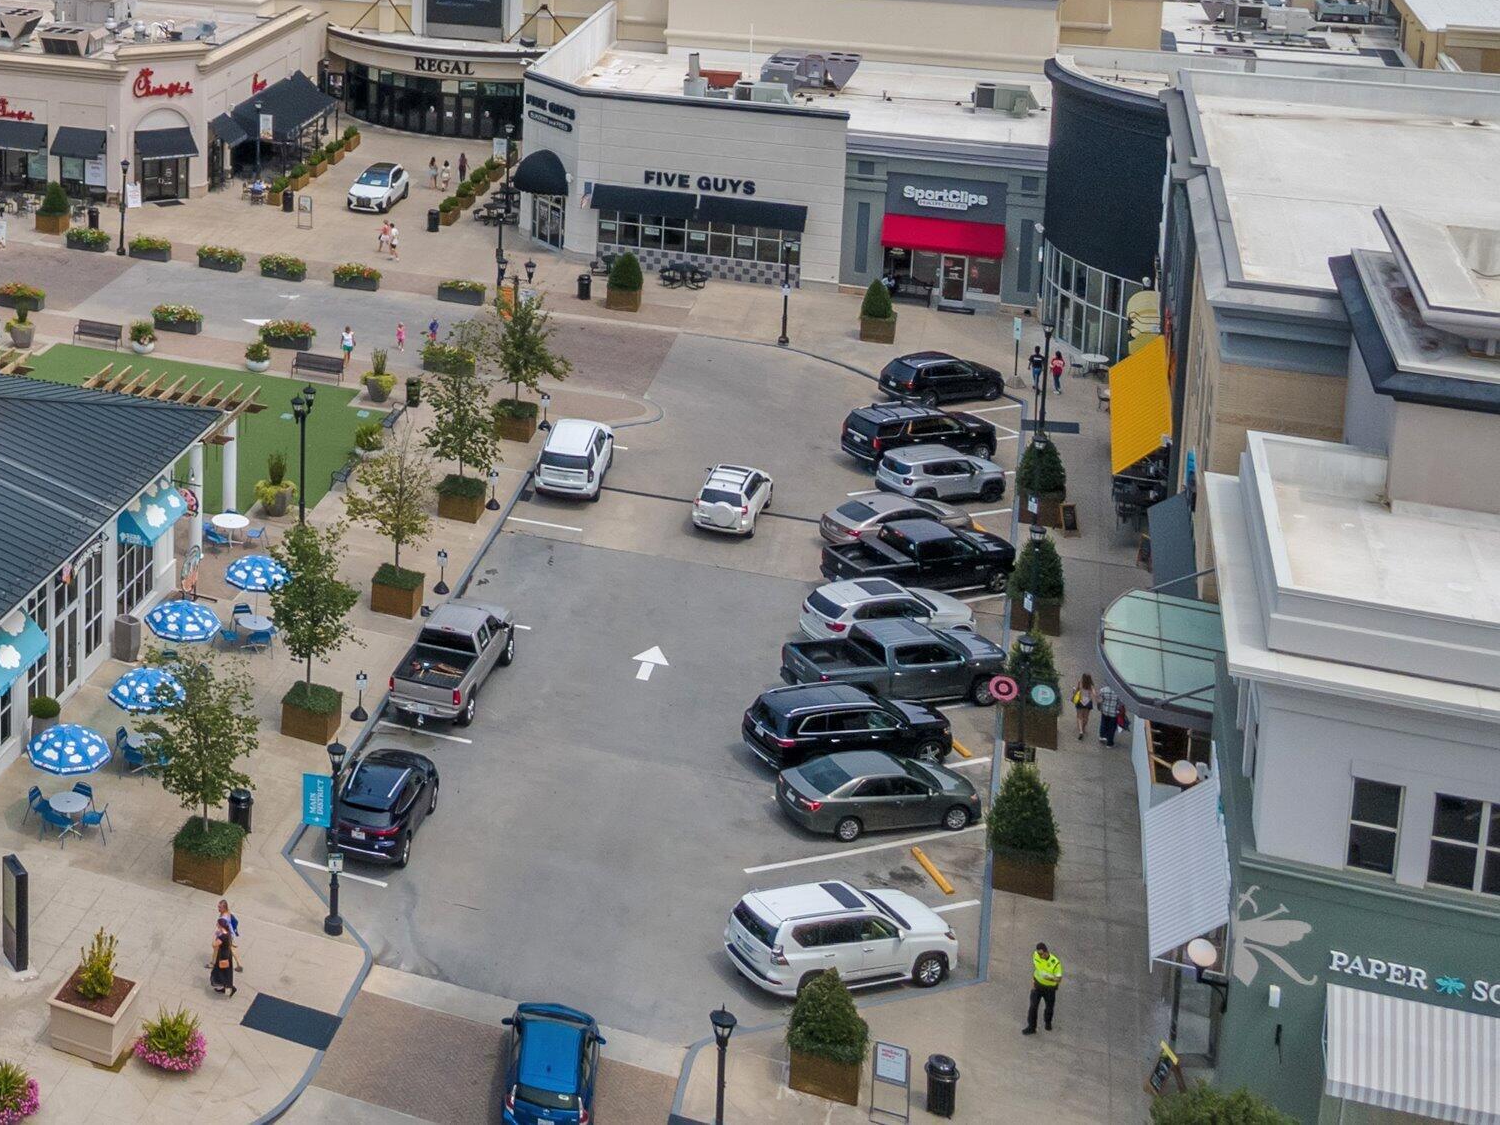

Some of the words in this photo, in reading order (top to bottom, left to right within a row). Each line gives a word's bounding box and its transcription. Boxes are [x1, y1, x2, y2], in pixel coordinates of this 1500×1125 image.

[414, 57, 475, 75] REGAL
[644, 170, 690, 189] FIVE
[697, 176, 756, 195] GUYS
[309, 792, 318, 815] MAIN
[317, 779, 325, 816] DISTRICT
[1328, 950, 1429, 990] PAPER
